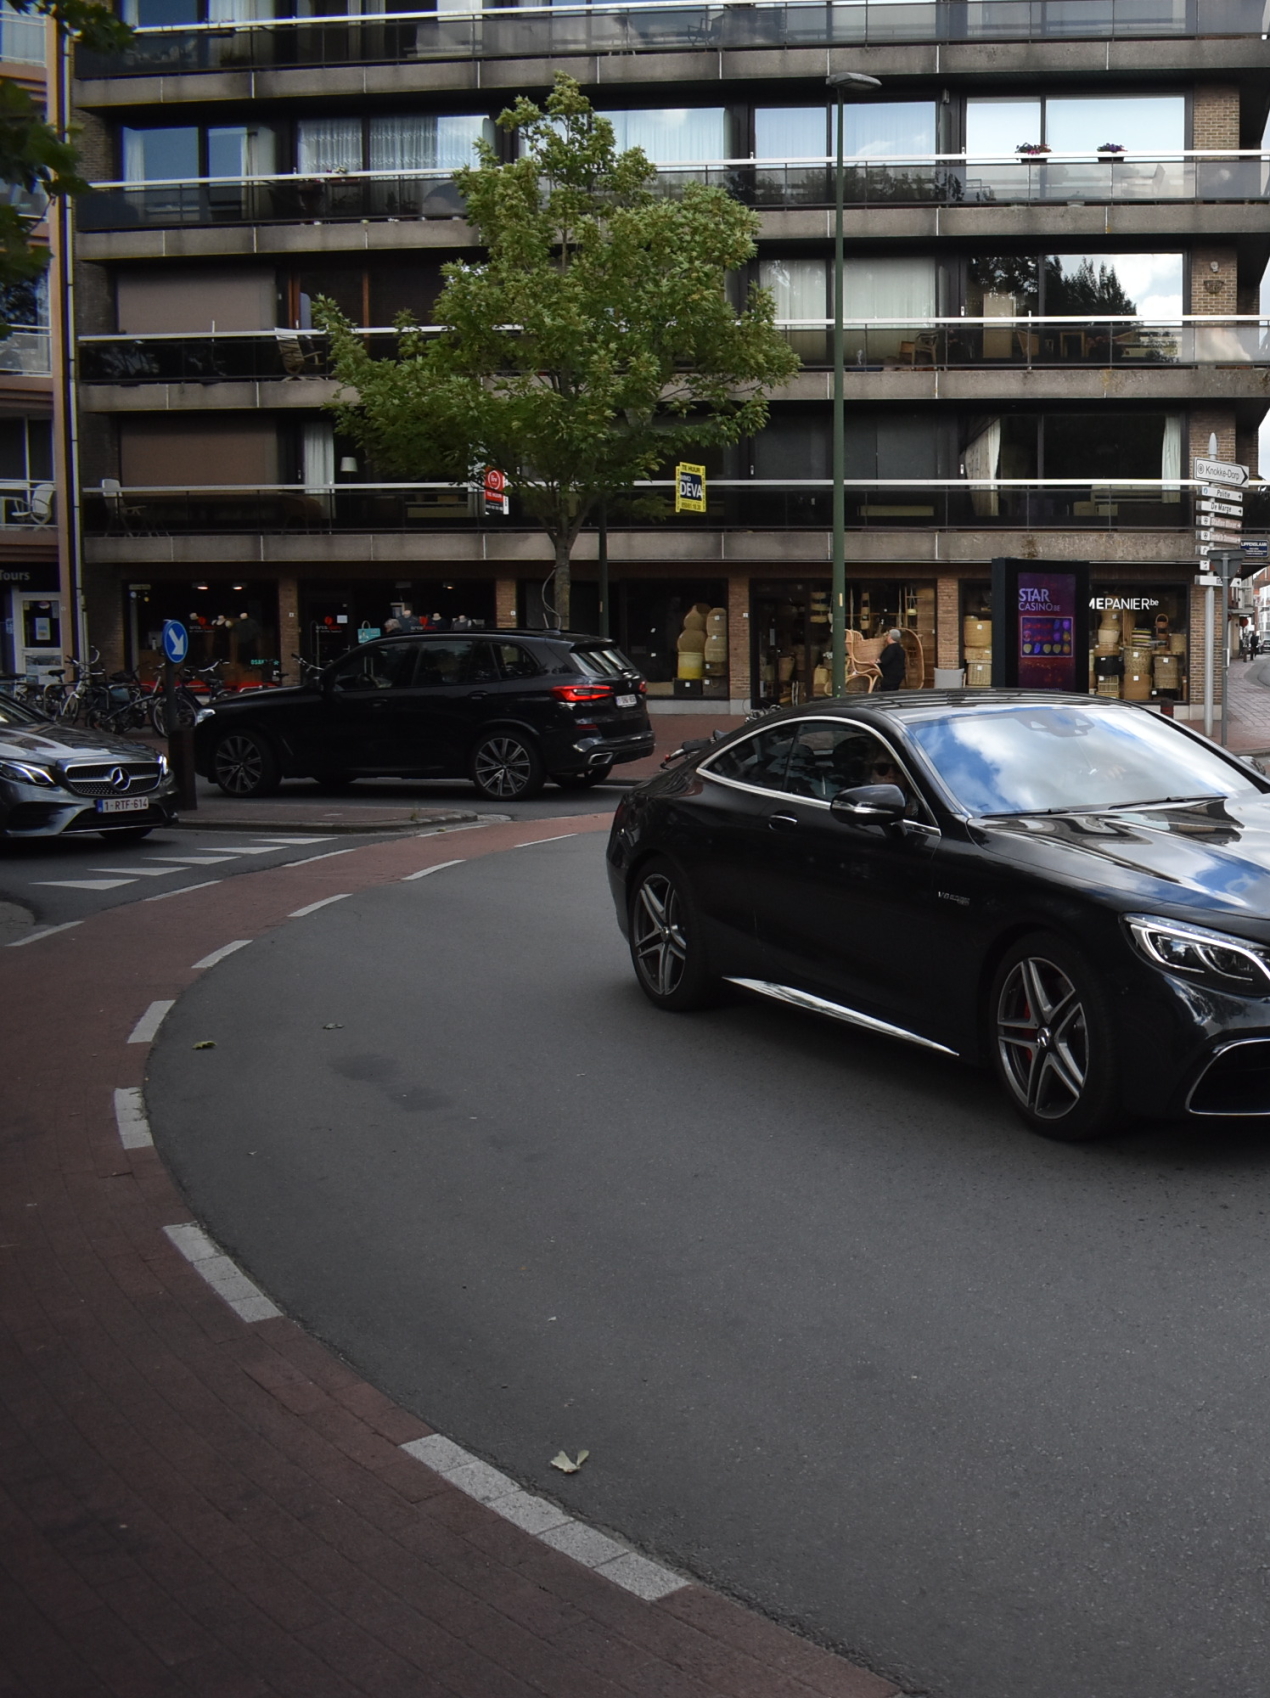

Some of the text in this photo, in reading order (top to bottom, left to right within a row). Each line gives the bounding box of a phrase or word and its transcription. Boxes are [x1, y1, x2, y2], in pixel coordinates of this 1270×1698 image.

[1206, 465, 1240, 481] Knokke-Dorp
[680, 481, 703, 499] DEVA
[1216, 490, 1231, 499] Politie
[1211, 502, 1232, 514] De Marge
[1018, 588, 1050, 603] STAR
[105, 798, 147, 811] 1-RTF-614
